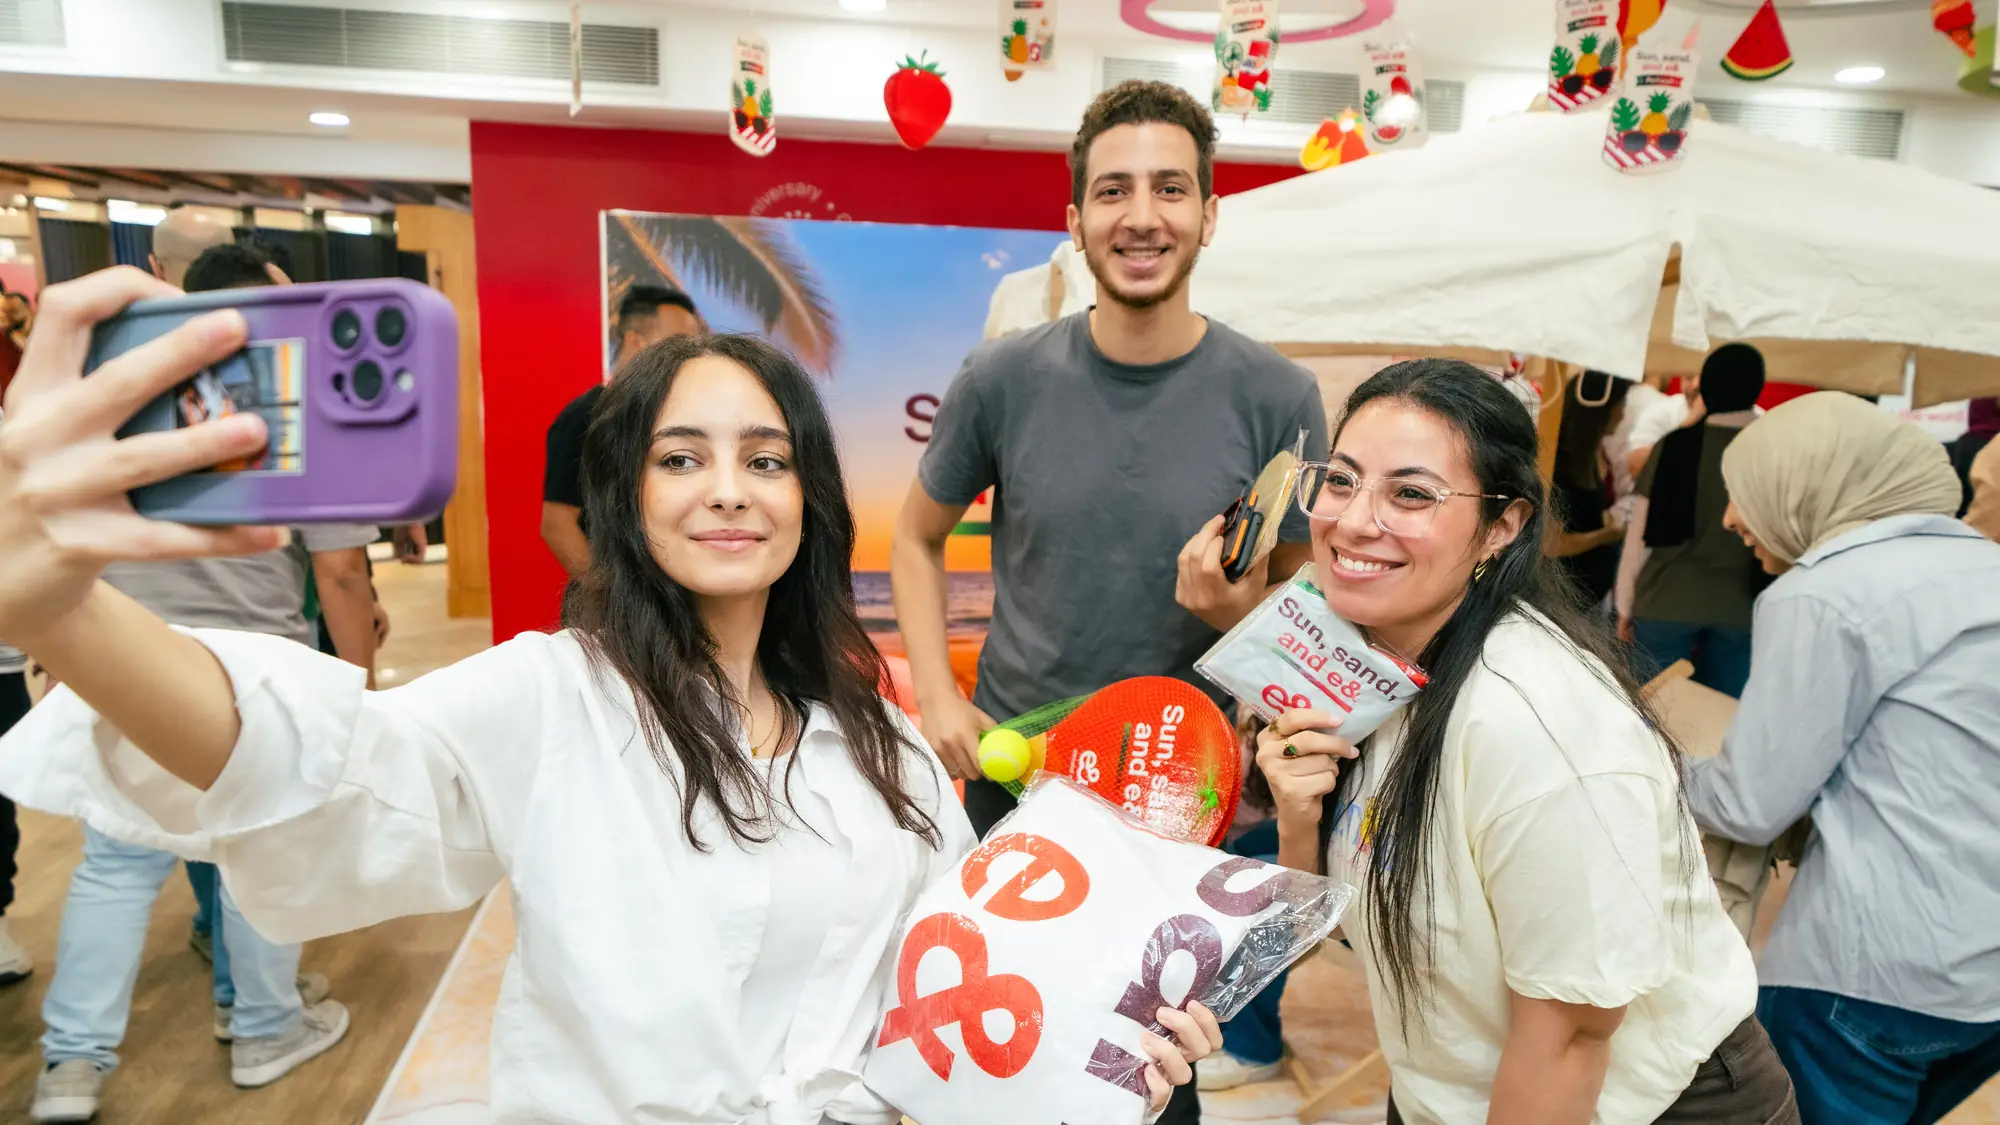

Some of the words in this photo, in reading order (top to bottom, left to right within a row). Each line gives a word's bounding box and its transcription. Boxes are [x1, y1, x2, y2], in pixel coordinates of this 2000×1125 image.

[749, 181, 822, 216] niversary
[1277, 631, 1327, 673] and
[1326, 671, 1362, 703] e&
[1278, 597, 1326, 650] Sun,
[1331, 646, 1400, 702] sand,
[1128, 722, 1152, 776] and
[1150, 704, 1184, 768] Sun,
[1144, 774, 1169, 823] san
[877, 832, 1091, 1083] e&
